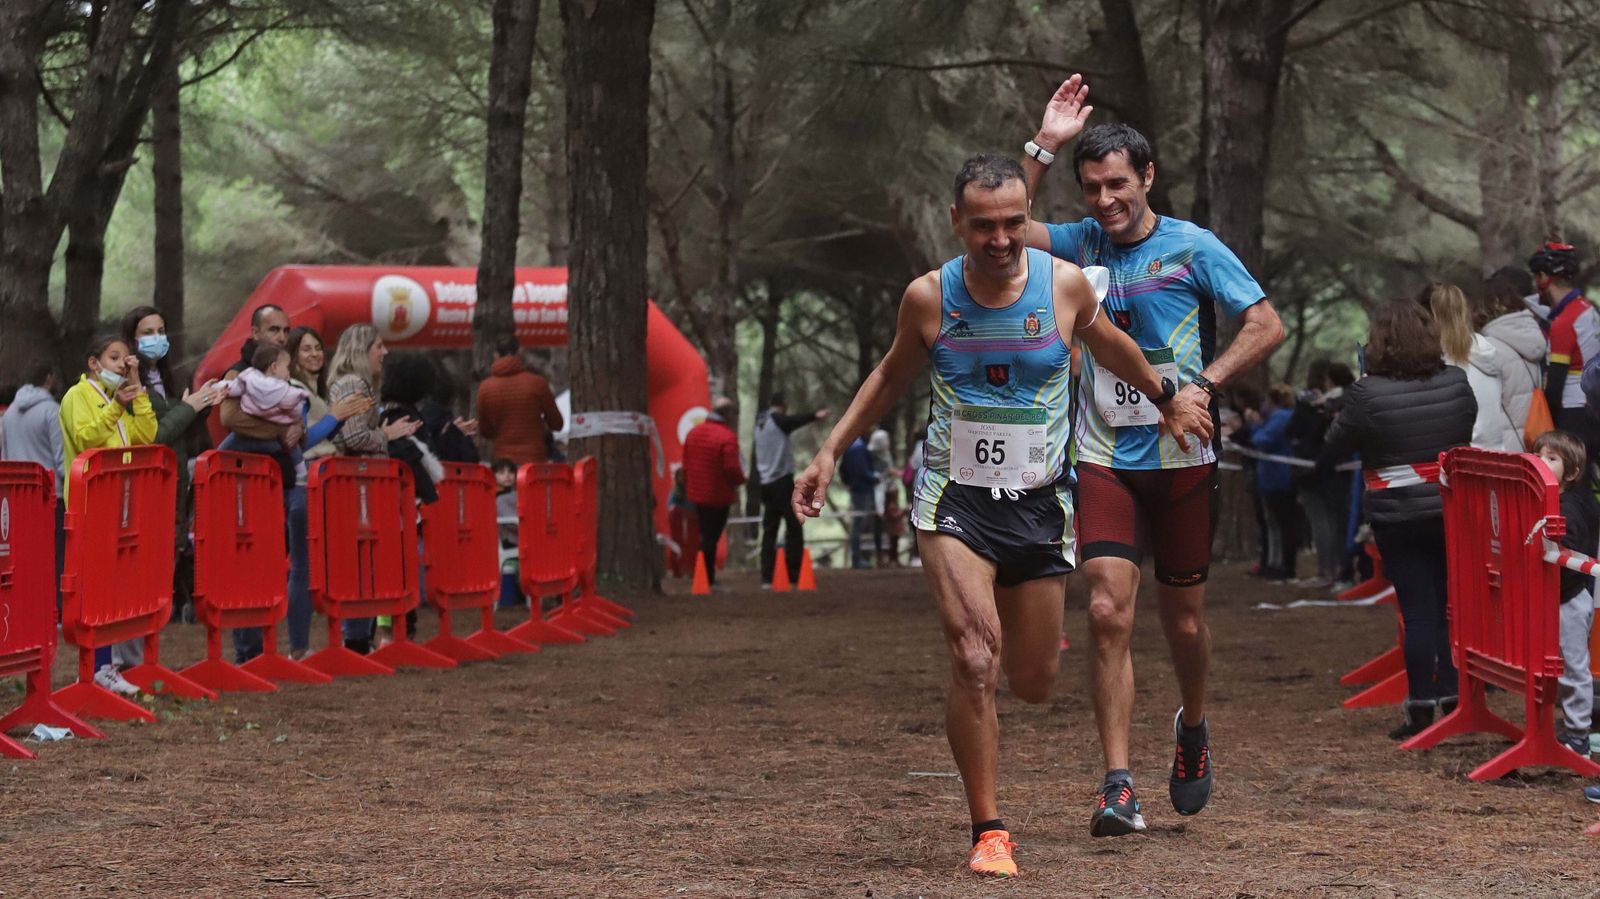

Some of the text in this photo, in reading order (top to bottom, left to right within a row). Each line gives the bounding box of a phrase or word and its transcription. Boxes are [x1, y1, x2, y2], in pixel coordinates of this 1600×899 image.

[1115, 381, 1141, 406] 98
[961, 410, 988, 420] CROSS
[989, 412, 1015, 421] PINAR
[975, 438, 1006, 466] 65
